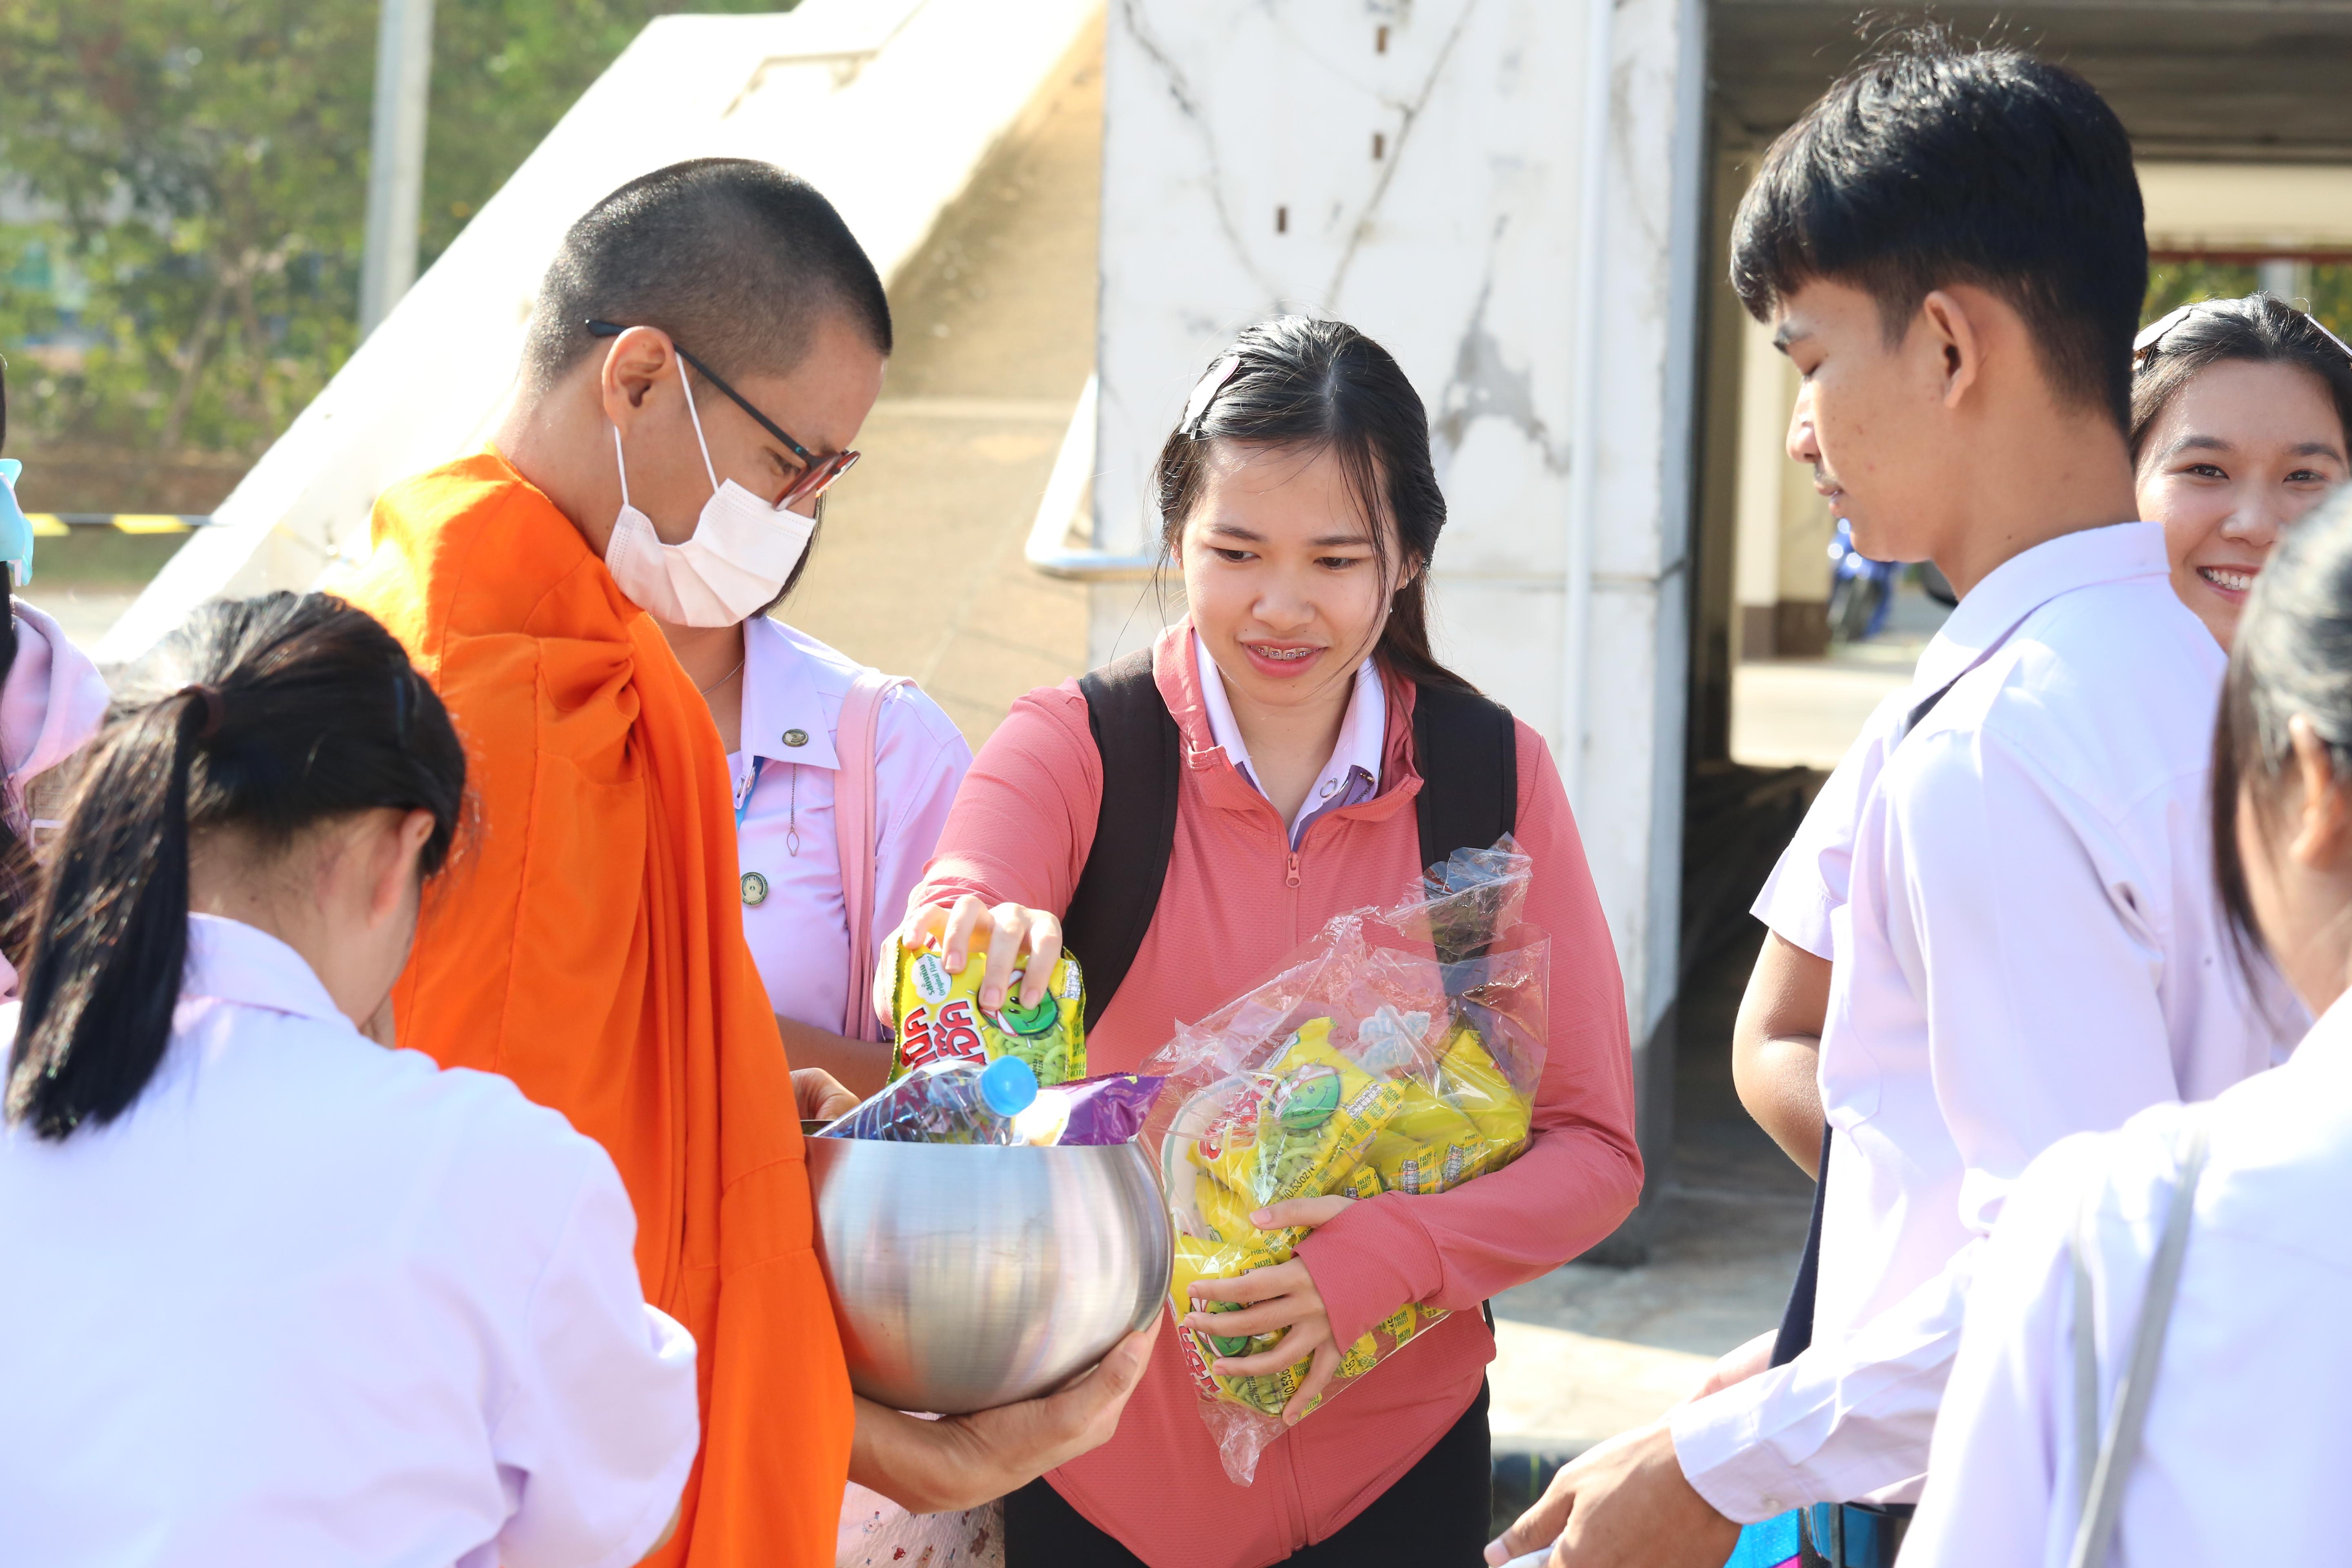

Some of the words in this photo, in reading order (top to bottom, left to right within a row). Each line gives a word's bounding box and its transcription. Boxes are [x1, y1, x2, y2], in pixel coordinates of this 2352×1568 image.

[927, 956, 937, 972] Flavor
[920, 964, 935, 996] รสดั้งเดิม
[932, 973, 946, 996] Original
[1381, 1091, 1396, 1106] FRIED
[1385, 1086, 1400, 1100] NON
[1372, 1102, 1385, 1115] NON
[1352, 1122, 1366, 1135] FRIED
[1358, 1117, 1372, 1130] NON
[1420, 1151, 1432, 1162] NON
[1420, 1158, 1431, 1169] FRIED
[1283, 1168, 1313, 1199] (0.53oz)
[1357, 1174, 1371, 1186] NON
[1358, 1180, 1372, 1192] FRIED
[1254, 1258, 1271, 1268] NON
[1394, 1310, 1407, 1322] NON
[1395, 1316, 1408, 1329] FRIED
[1398, 1327, 1410, 1340] NON
